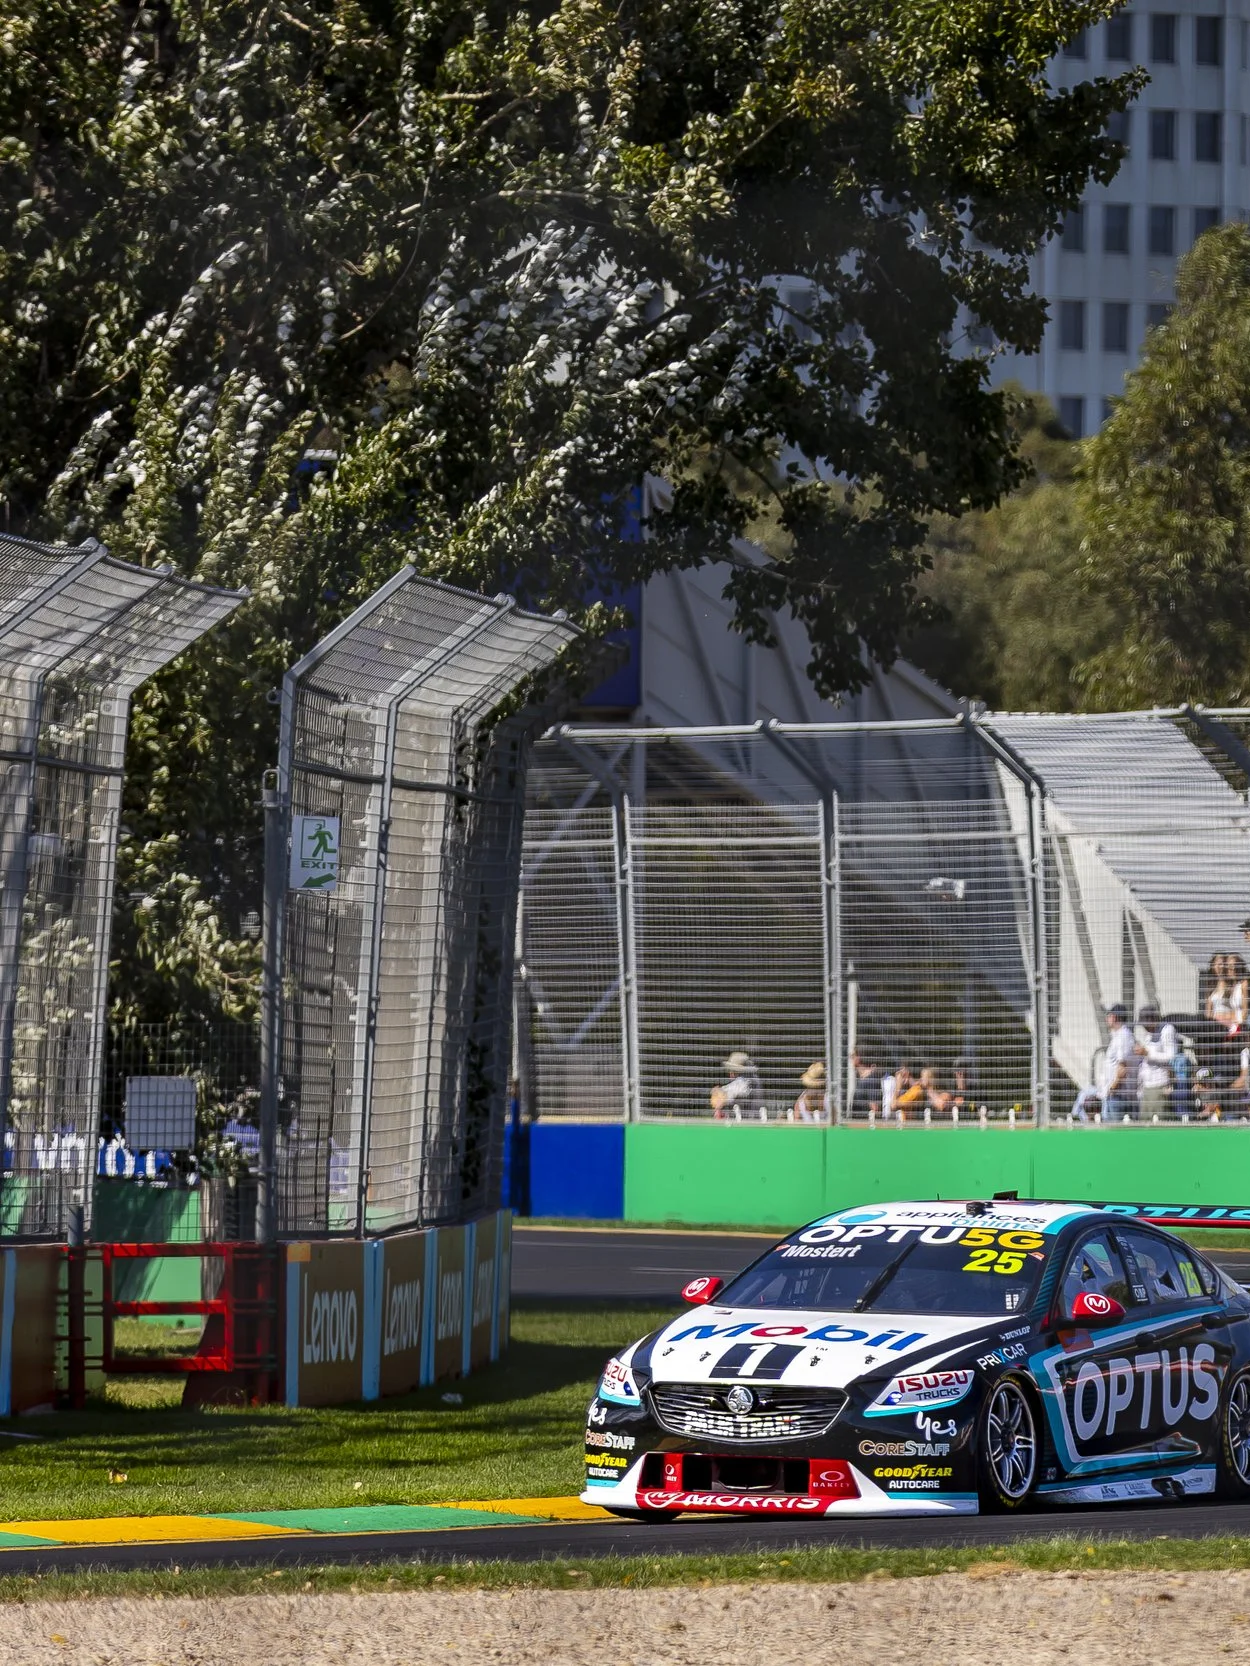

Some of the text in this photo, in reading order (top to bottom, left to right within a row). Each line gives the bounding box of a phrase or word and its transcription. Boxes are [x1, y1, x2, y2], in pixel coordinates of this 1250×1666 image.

[301, 861, 337, 869] EXIT
[951, 1218, 1040, 1231] online
[780, 1244, 862, 1258] Mostert
[961, 1249, 1028, 1275] 25
[1180, 1262, 1204, 1296] 25
[303, 1272, 358, 1364] Lenovo
[383, 1268, 421, 1356] Lenovo
[667, 1323, 928, 1352] Mobil
[1005, 1325, 1031, 1340] DUNLOP
[737, 1342, 776, 1377] 1
[976, 1343, 1028, 1371] PRIXCAR
[898, 1371, 969, 1394] ISUZU
[915, 1387, 961, 1401] TRUCKS
[1074, 1343, 1219, 1441] OPTUS
[873, 1464, 953, 1479] GOODYEAR
[889, 1480, 940, 1489] AUTOCARE
[682, 1493, 822, 1509] MORRIS
